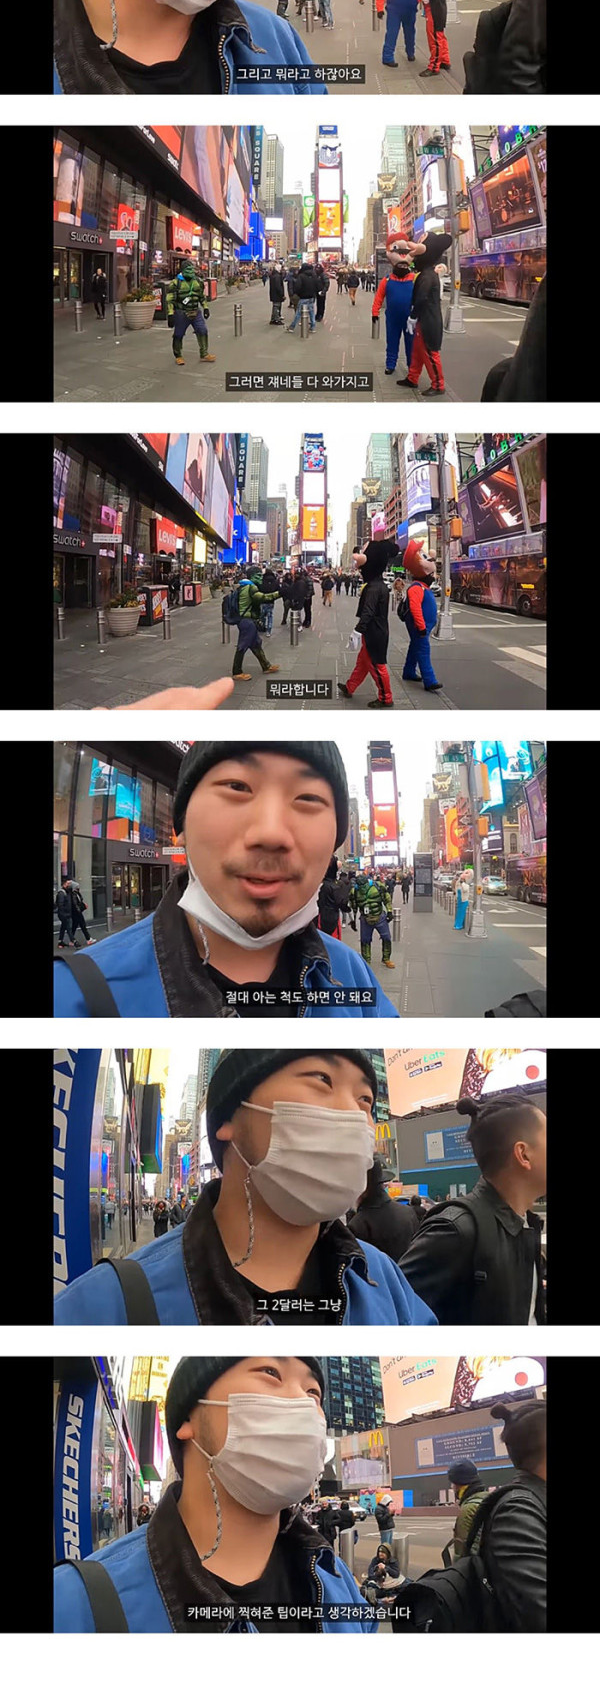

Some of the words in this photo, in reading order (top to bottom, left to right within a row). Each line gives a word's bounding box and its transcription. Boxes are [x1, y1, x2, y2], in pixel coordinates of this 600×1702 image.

[404, 1056, 423, 1071] Uber
[423, 1051, 446, 1064] Eats
[62, 1394, 84, 1560] SKECHERS
